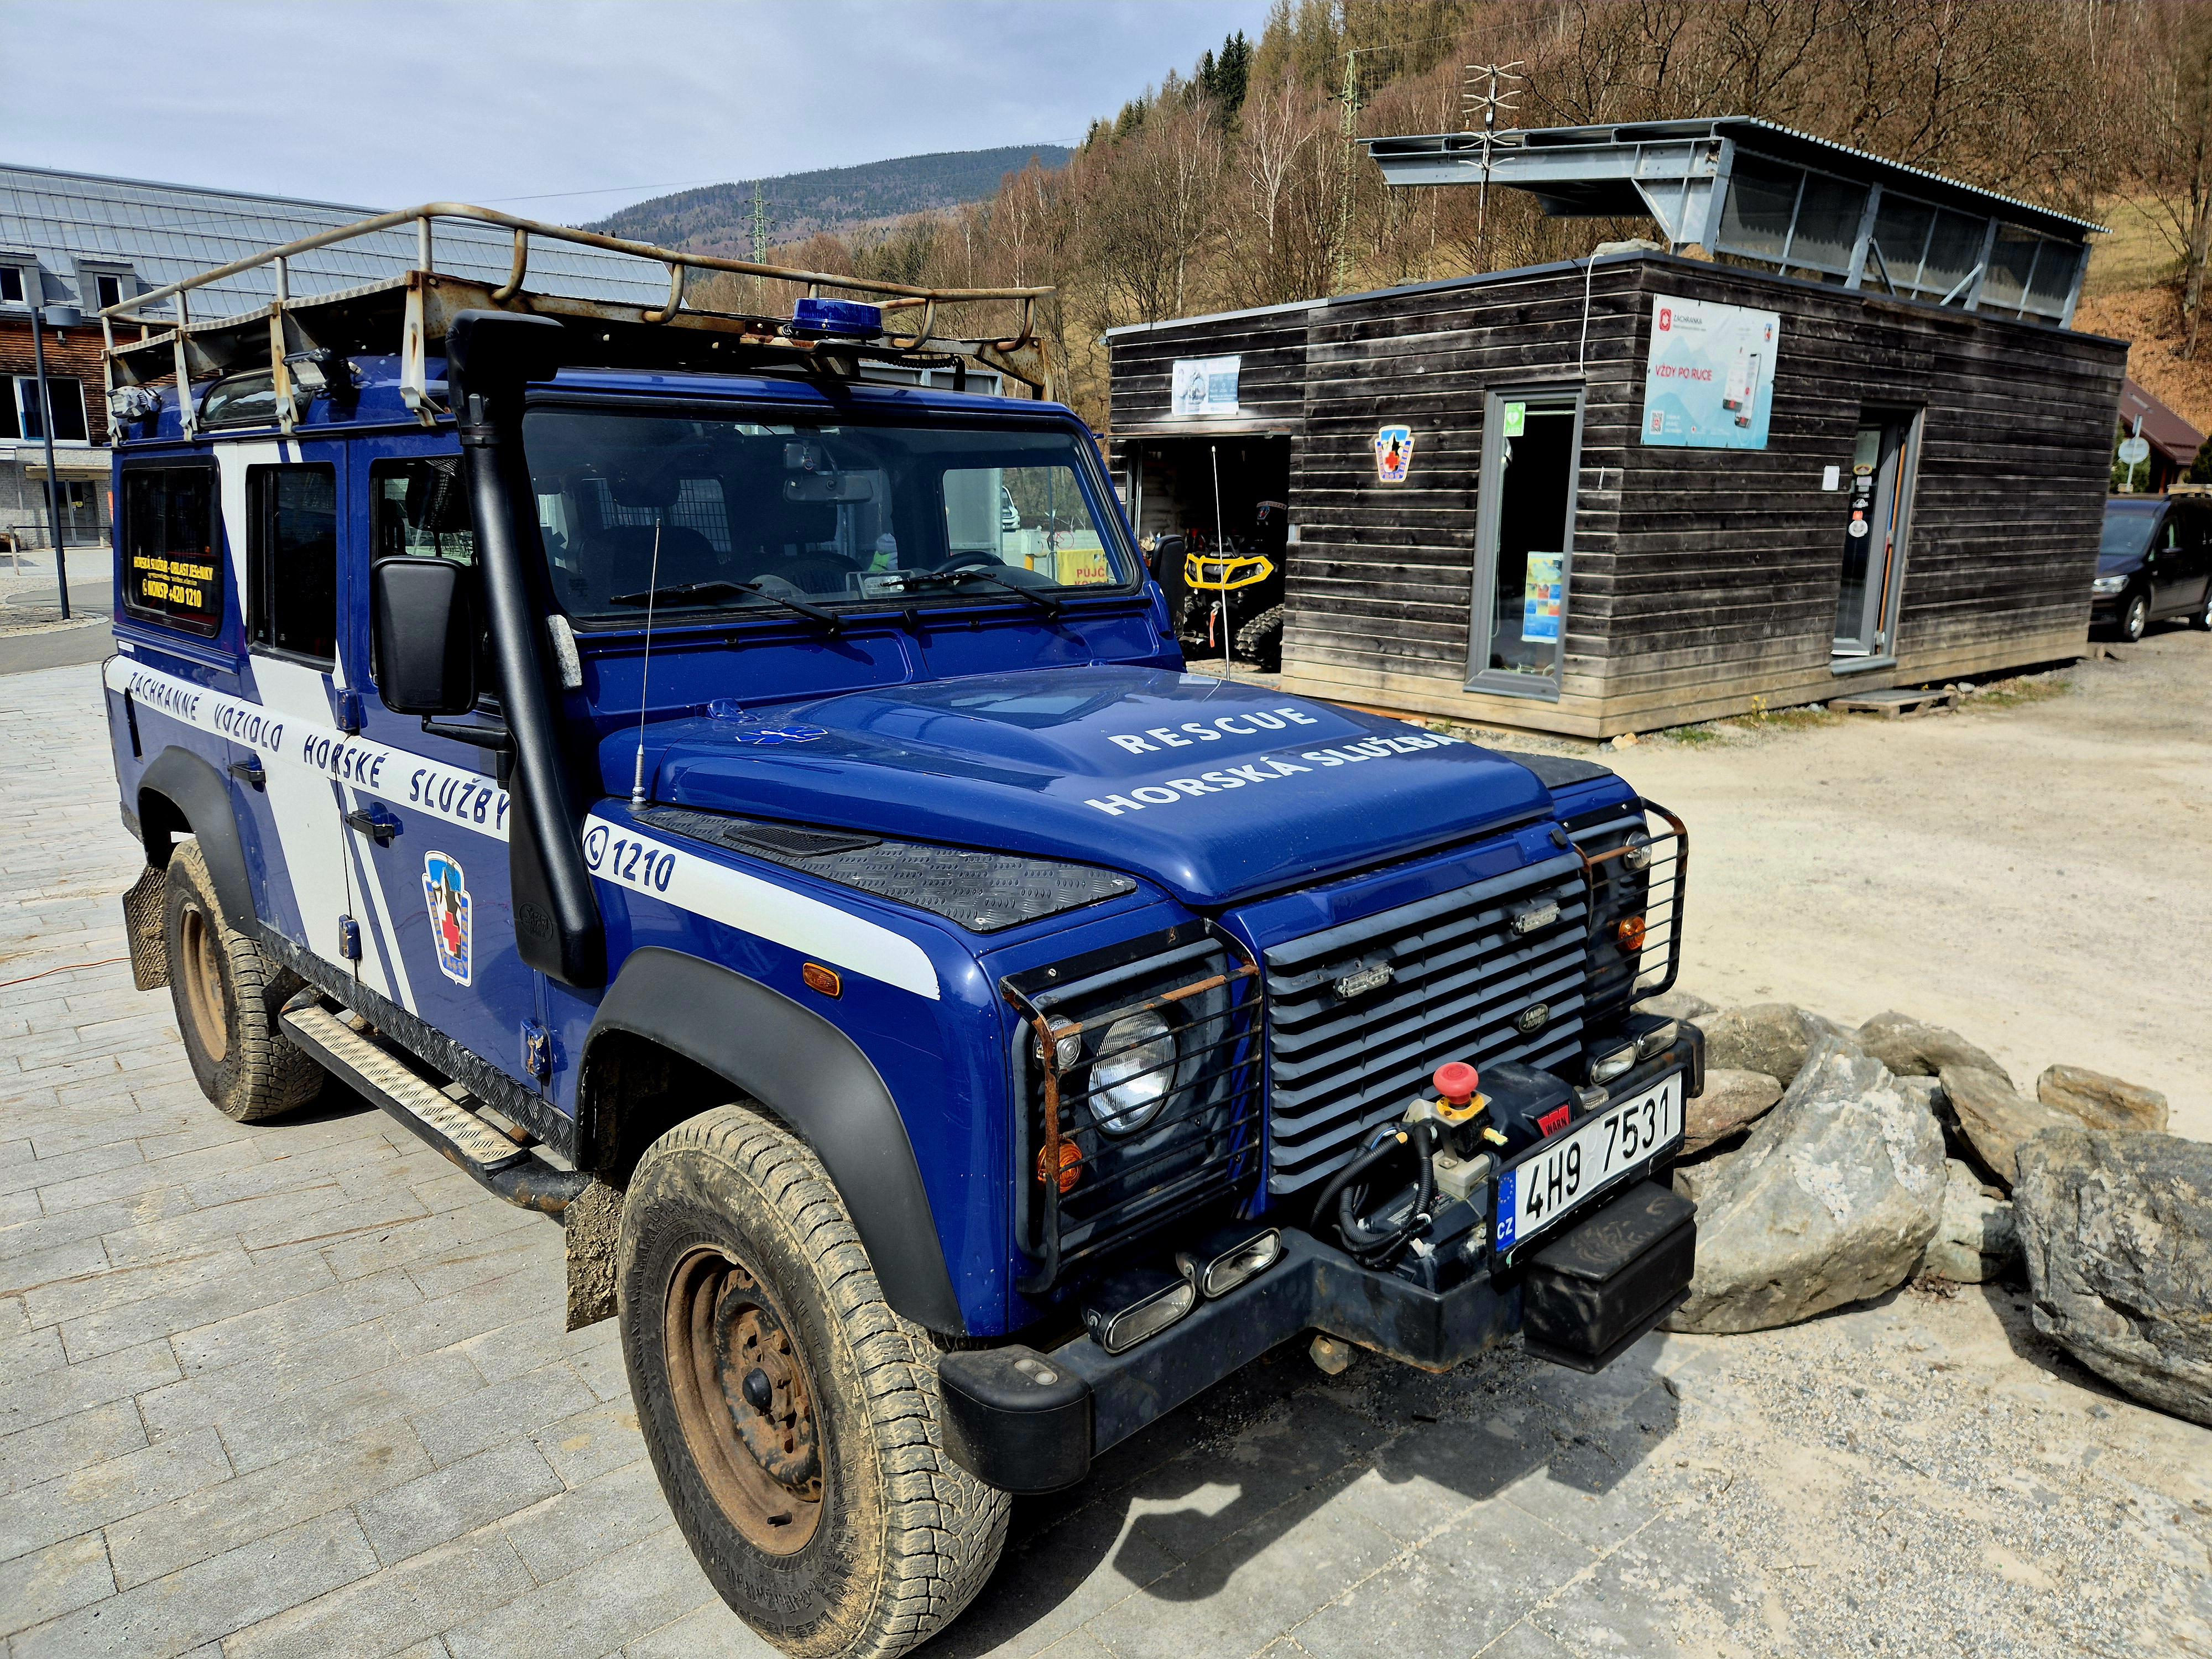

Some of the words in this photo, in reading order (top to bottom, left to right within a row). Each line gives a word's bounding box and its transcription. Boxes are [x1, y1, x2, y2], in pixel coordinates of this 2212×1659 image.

[1656, 363, 1676, 378] VŽDY
[1678, 367, 1689, 379] PO
[1691, 367, 1713, 382] RUCE
[185, 588, 202, 608] 1210
[1107, 707, 1318, 754] RESCUE
[129, 672, 203, 721] ZÁCHRANNÉ
[213, 703, 283, 753] VOZIDLO
[304, 734, 389, 790] HORSKÉ
[409, 769, 510, 830] SLUŽBY
[1083, 756, 1313, 816] HORSKÁ
[1300, 733, 1464, 767] SLUŽBA
[613, 839, 676, 893] 1210
[1525, 1008, 1542, 1021] LAND
[1526, 1014, 1545, 1029] ROVER
[1545, 1115, 1567, 1135] WARN
[1525, 1141, 1581, 1220] 4H9
[1603, 1086, 1669, 1173] 7531
[1496, 1216, 1514, 1240] CZ
